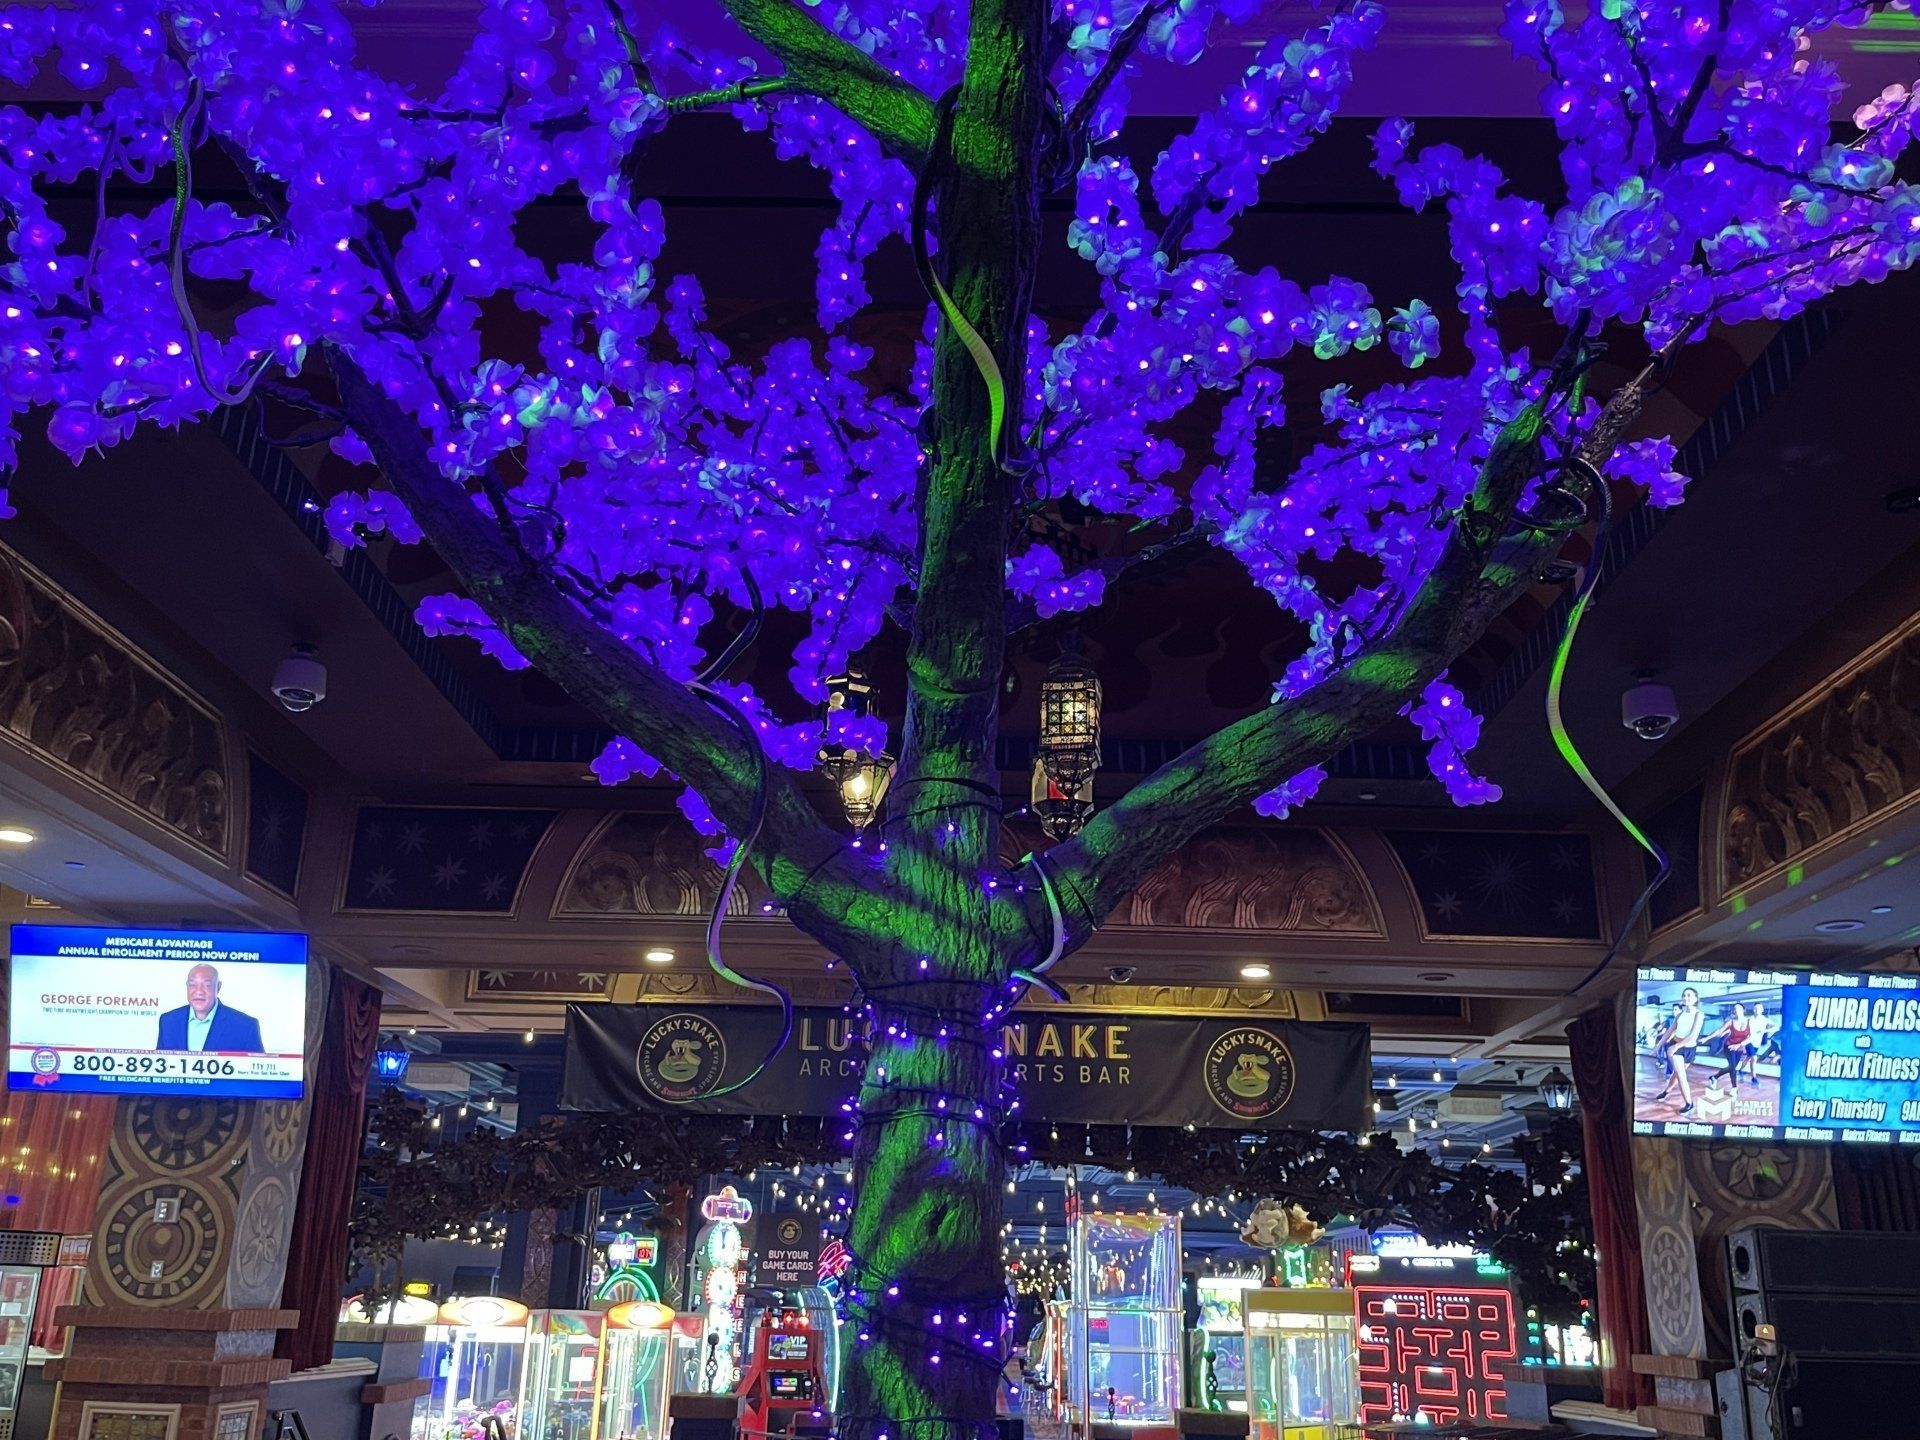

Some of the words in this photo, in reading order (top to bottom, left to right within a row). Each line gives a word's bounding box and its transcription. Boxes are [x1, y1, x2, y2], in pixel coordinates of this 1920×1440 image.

[106, 937, 153, 947] MEDICARE
[155, 938, 213, 949] ADVANTAGE
[58, 946, 99, 956] ANNUAL
[101, 947, 164, 958] ENROLLMENT
[165, 949, 200, 959] PERIOD
[202, 951, 228, 960] NOW
[229, 952, 260, 961] OPEN!
[41, 994, 92, 1005] GEORGE
[96, 996, 159, 1007] FOREMAN
[1805, 996, 1869, 1030] ZUMBA
[646, 1020, 681, 1049] LUCKY
[683, 1019, 719, 1050] SNAKE
[1855, 1035, 1871, 1048] with
[1212, 1034, 1245, 1063] LUCKY
[1247, 1033, 1287, 1064] SNAKE
[74, 1055, 234, 1075] 800-893-1406
[1806, 1050, 1861, 1078] Matrxx
[1862, 1052, 1920, 1080] Fitness
[1079, 1065, 1131, 1084] BAR
[1793, 1096, 1827, 1120] Every
[1829, 1097, 1886, 1122] Thursday
[768, 1250, 786, 1259] BUY
[786, 1250, 809, 1260] YOUR
[762, 1260, 786, 1270] GAME
[786, 1261, 814, 1271] CARDS
[776, 1271, 799, 1281] HERE
[789, 1335, 806, 1345] VIP
